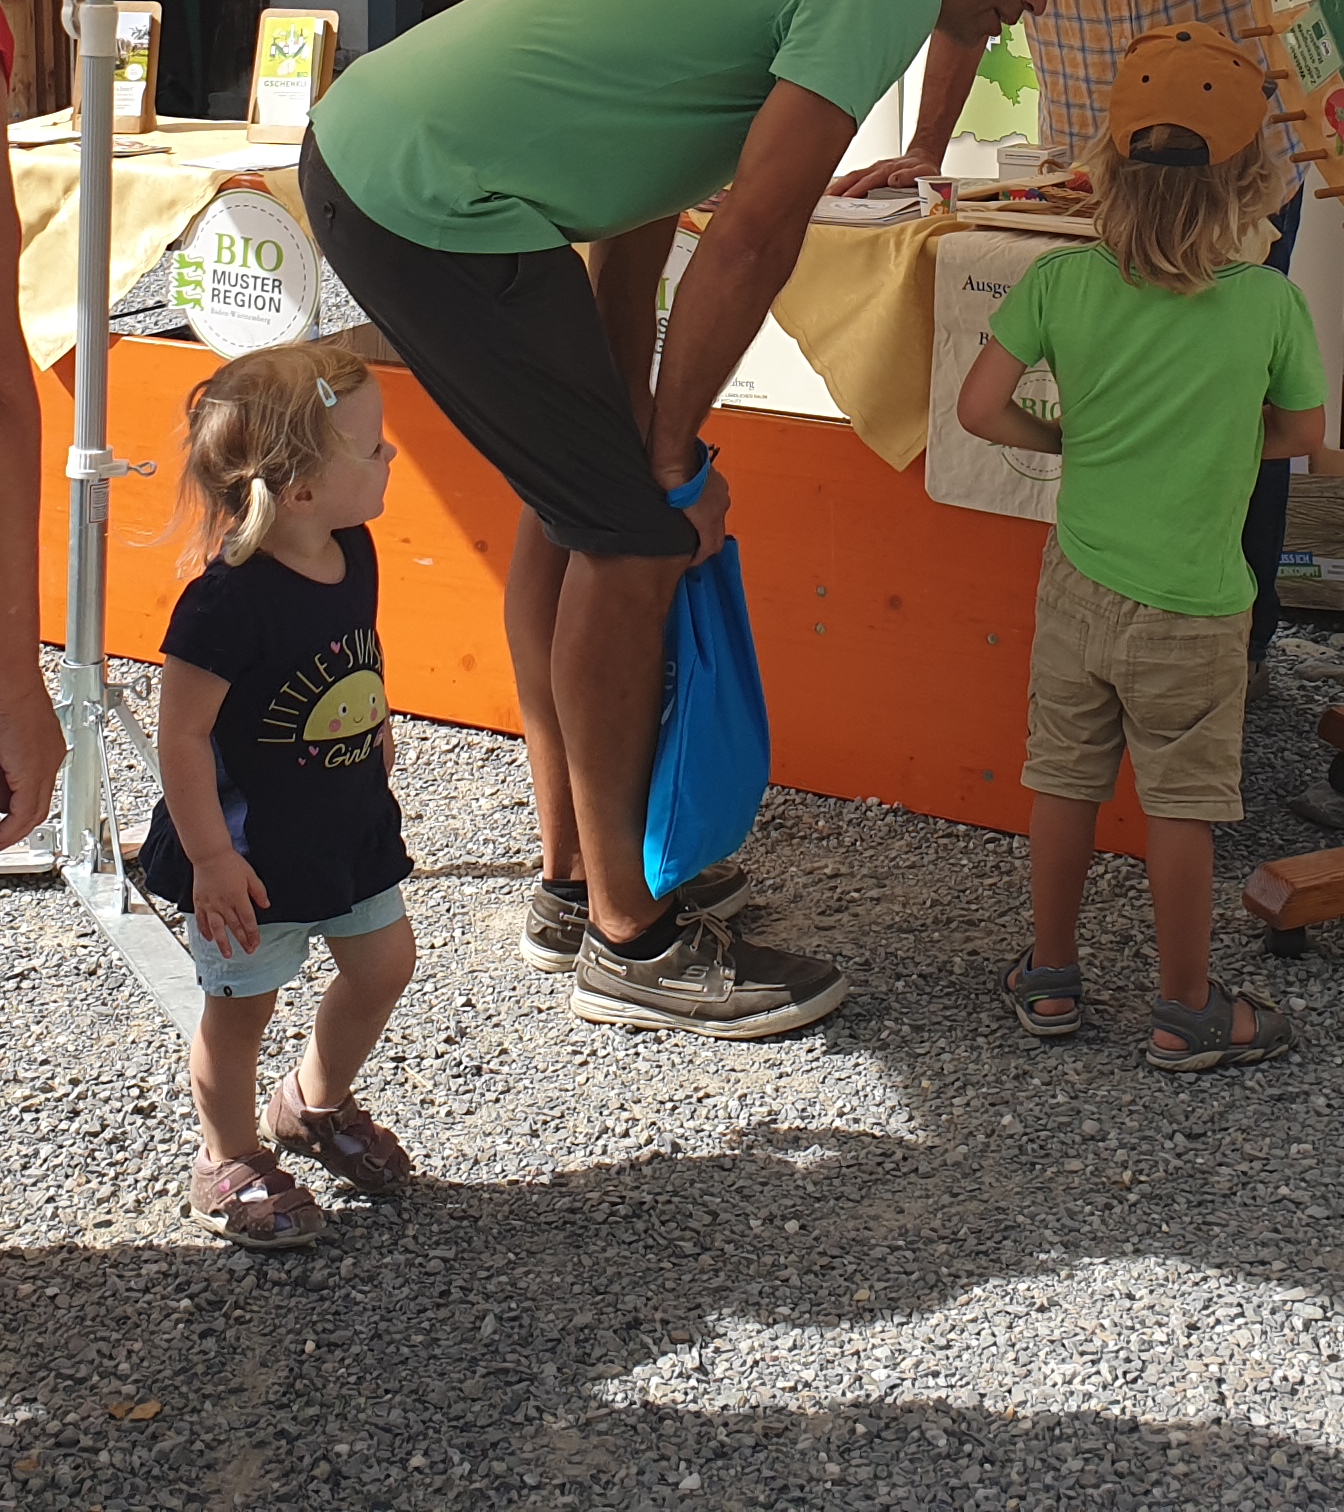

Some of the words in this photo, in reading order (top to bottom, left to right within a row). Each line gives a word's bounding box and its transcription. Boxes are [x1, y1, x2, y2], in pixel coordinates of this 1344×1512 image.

[1305, 28, 1324, 64] Regeln?
[1298, 49, 1317, 85] Zeichen
[1312, 65, 1322, 79] für
[213, 232, 284, 273] BIO
[211, 269, 283, 295] MUSTER
[961, 275, 1012, 299] Ausge
[210, 289, 282, 314] REGION
[257, 653, 335, 743] LITTLE
[342, 628, 382, 672] SUNS
[324, 734, 372, 768] Girl
